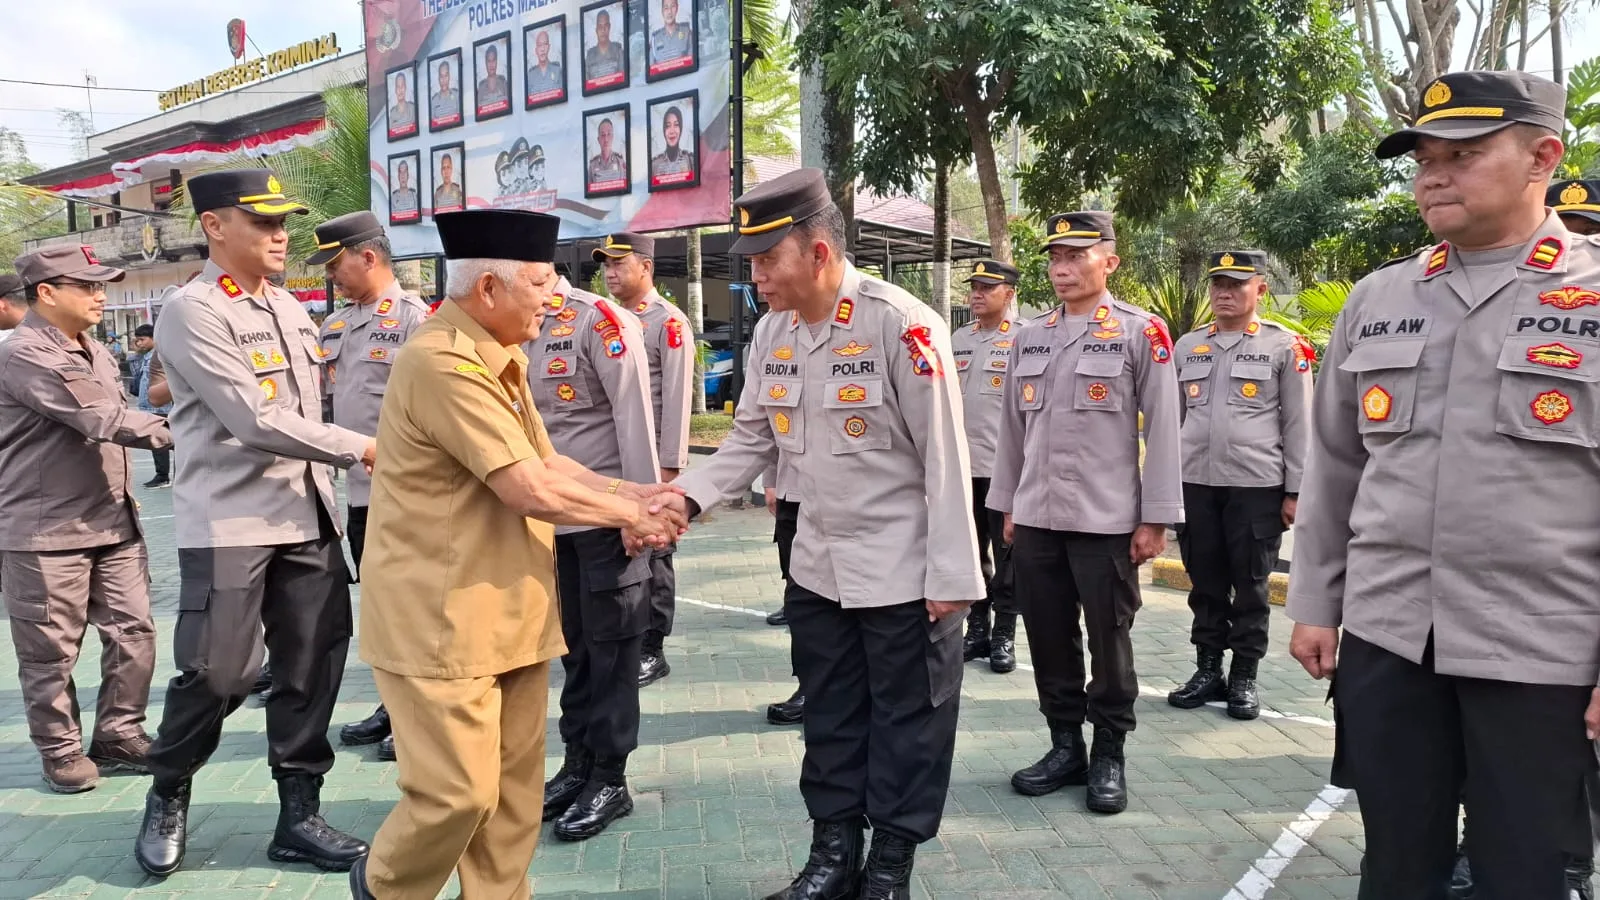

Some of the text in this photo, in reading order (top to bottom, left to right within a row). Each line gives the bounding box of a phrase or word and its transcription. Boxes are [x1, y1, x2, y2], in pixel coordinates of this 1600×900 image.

[469, 0, 513, 31] POLRES
[157, 32, 341, 111] SATUAN RESERSE KRIMINAL
[1358, 318, 1425, 340] ALEK AW
[1517, 316, 1600, 338] POLR
[369, 332, 400, 343] POLRI
[545, 340, 573, 353] POLRI
[1021, 346, 1051, 355] INDRA
[1082, 343, 1123, 353] POLRI
[1185, 354, 1214, 363] YOYOK
[1235, 354, 1270, 362] POLRI
[765, 363, 798, 376] BUDI.M
[832, 360, 875, 376] POLRI
